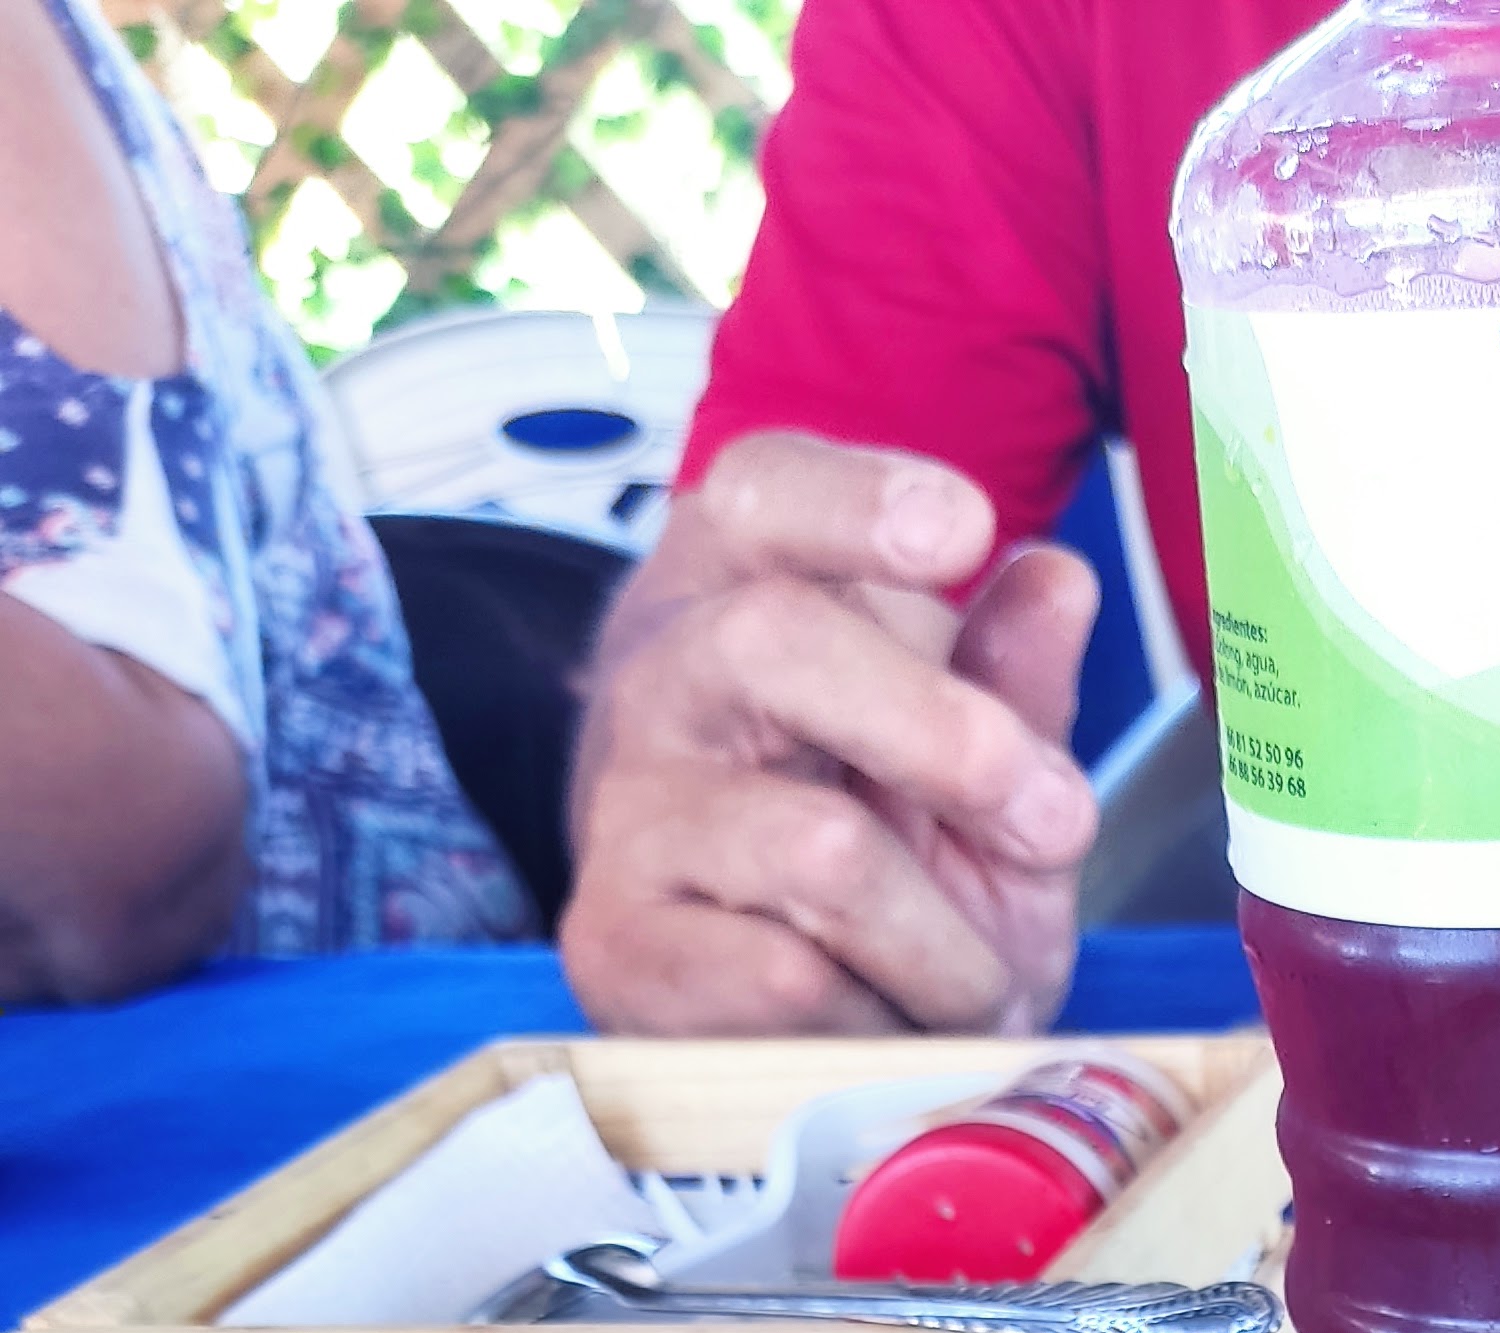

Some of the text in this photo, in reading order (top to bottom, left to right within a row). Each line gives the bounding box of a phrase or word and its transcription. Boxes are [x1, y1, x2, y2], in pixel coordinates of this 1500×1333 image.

[1246, 651, 1279, 679] agua,
[1249, 735, 1262, 761] 52
[1265, 741, 1281, 765] 50
[1285, 746, 1304, 770] 96
[1250, 765, 1265, 788] 56
[1267, 770, 1283, 793] 39
[1287, 776, 1306, 799] 68
